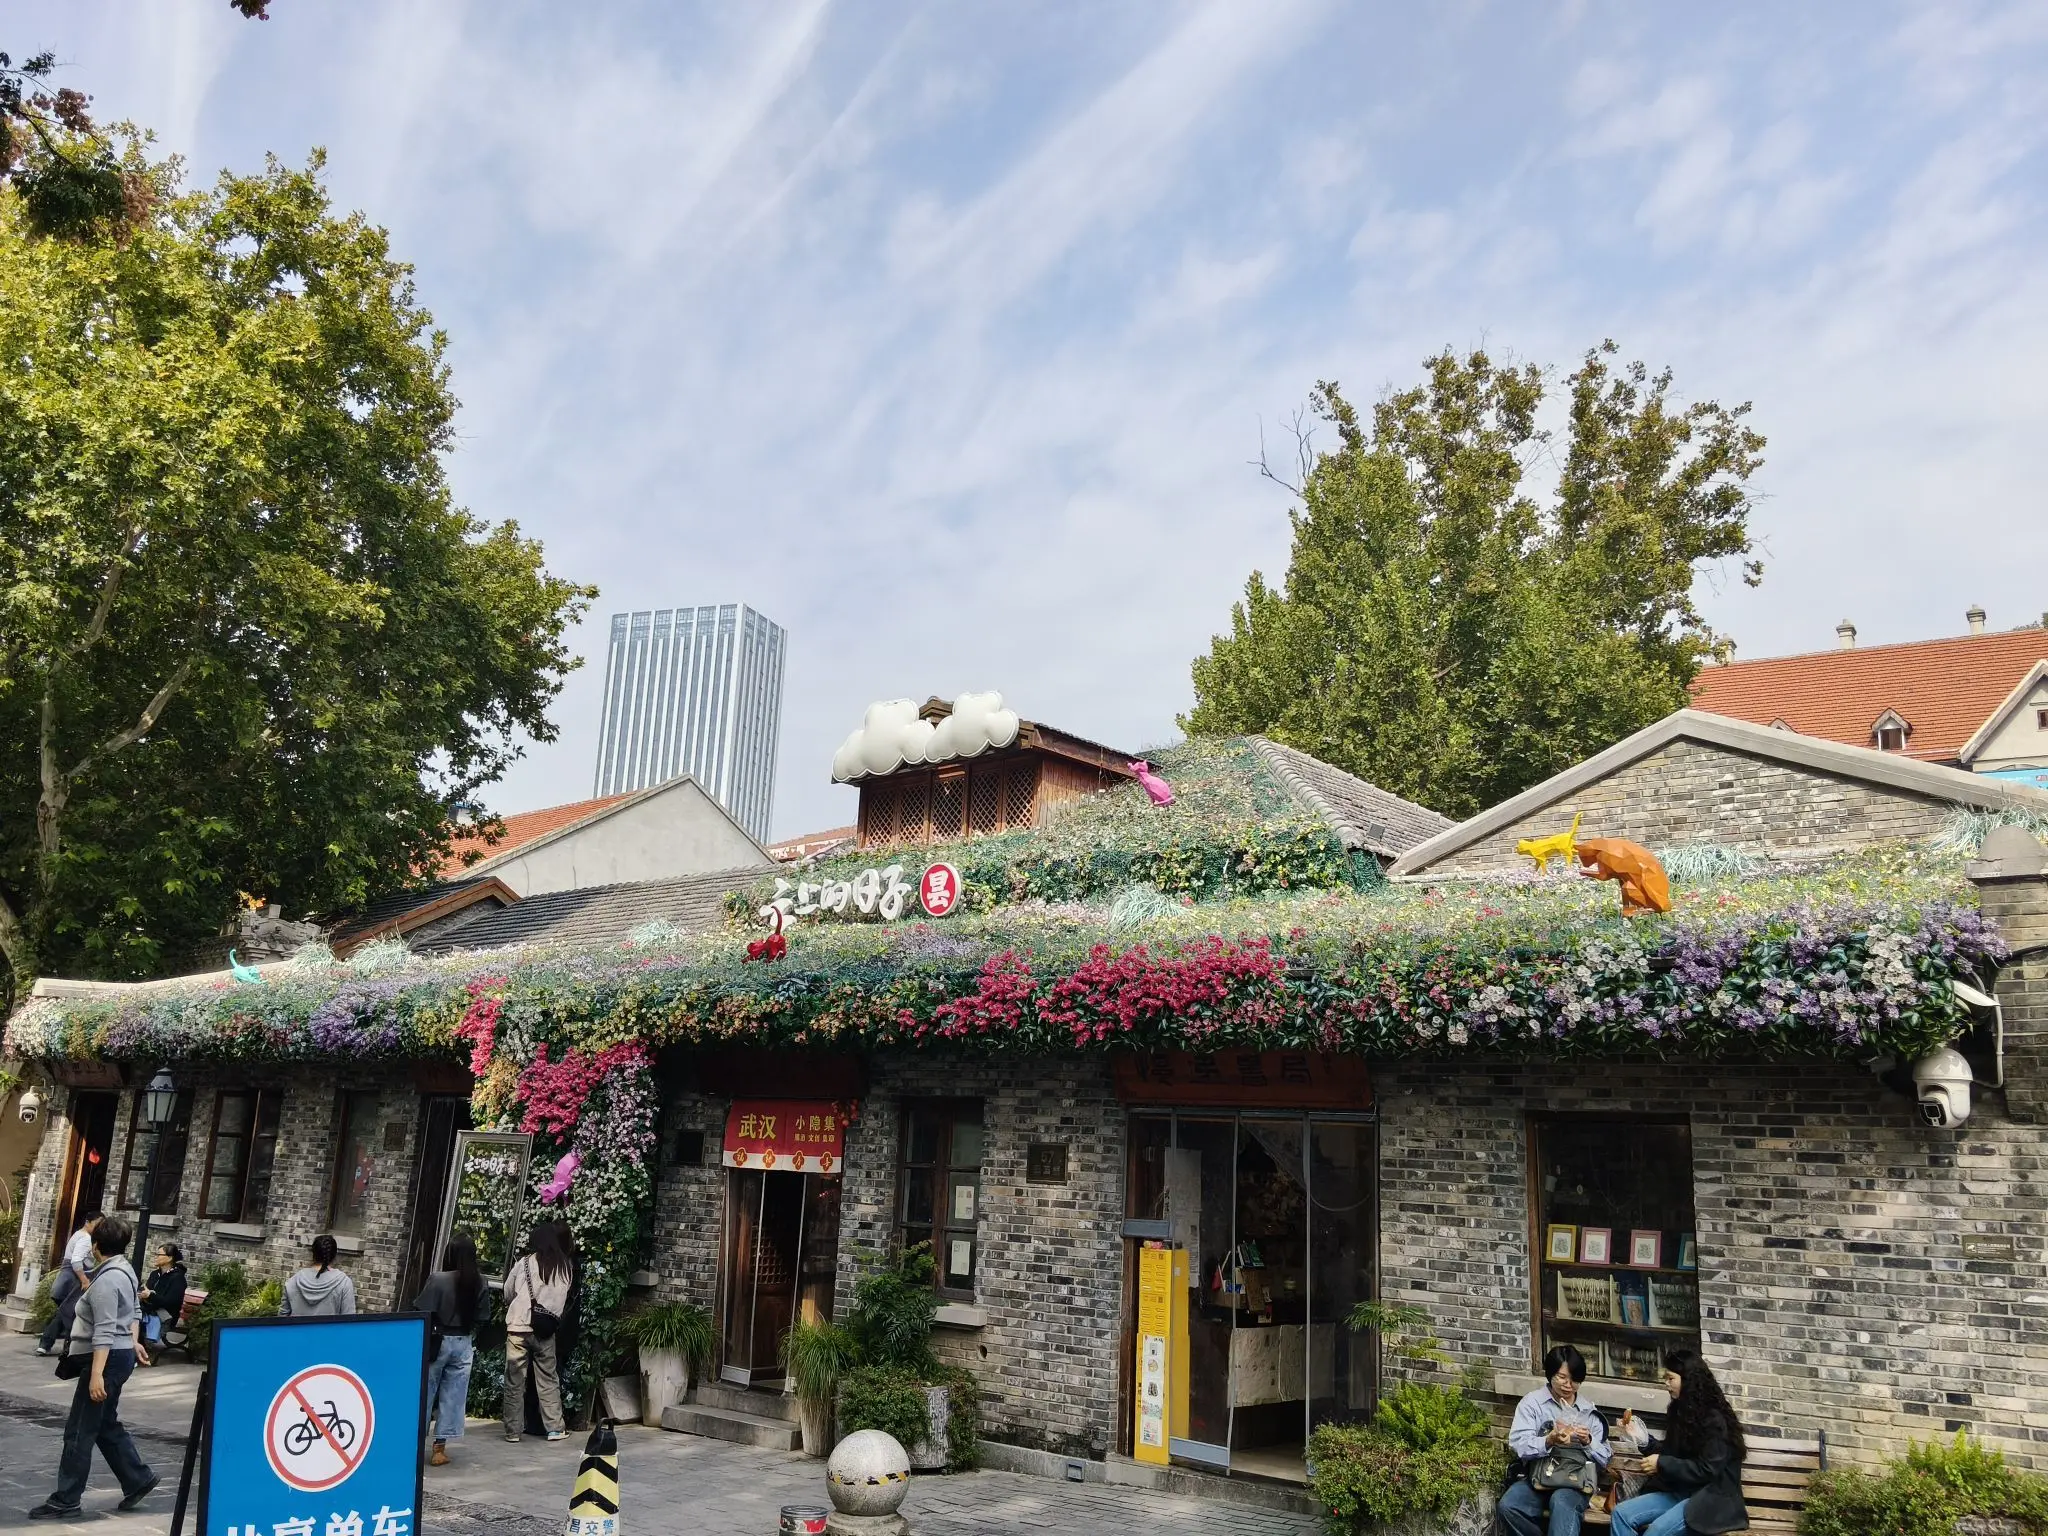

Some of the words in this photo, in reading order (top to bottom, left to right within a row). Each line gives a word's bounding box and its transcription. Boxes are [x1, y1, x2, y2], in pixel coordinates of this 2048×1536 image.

[927, 869, 951, 910] 昙
[738, 1113, 777, 1140] 武汉
[795, 1115, 835, 1131] 小隐集
[227, 1505, 413, 1536] 单车
